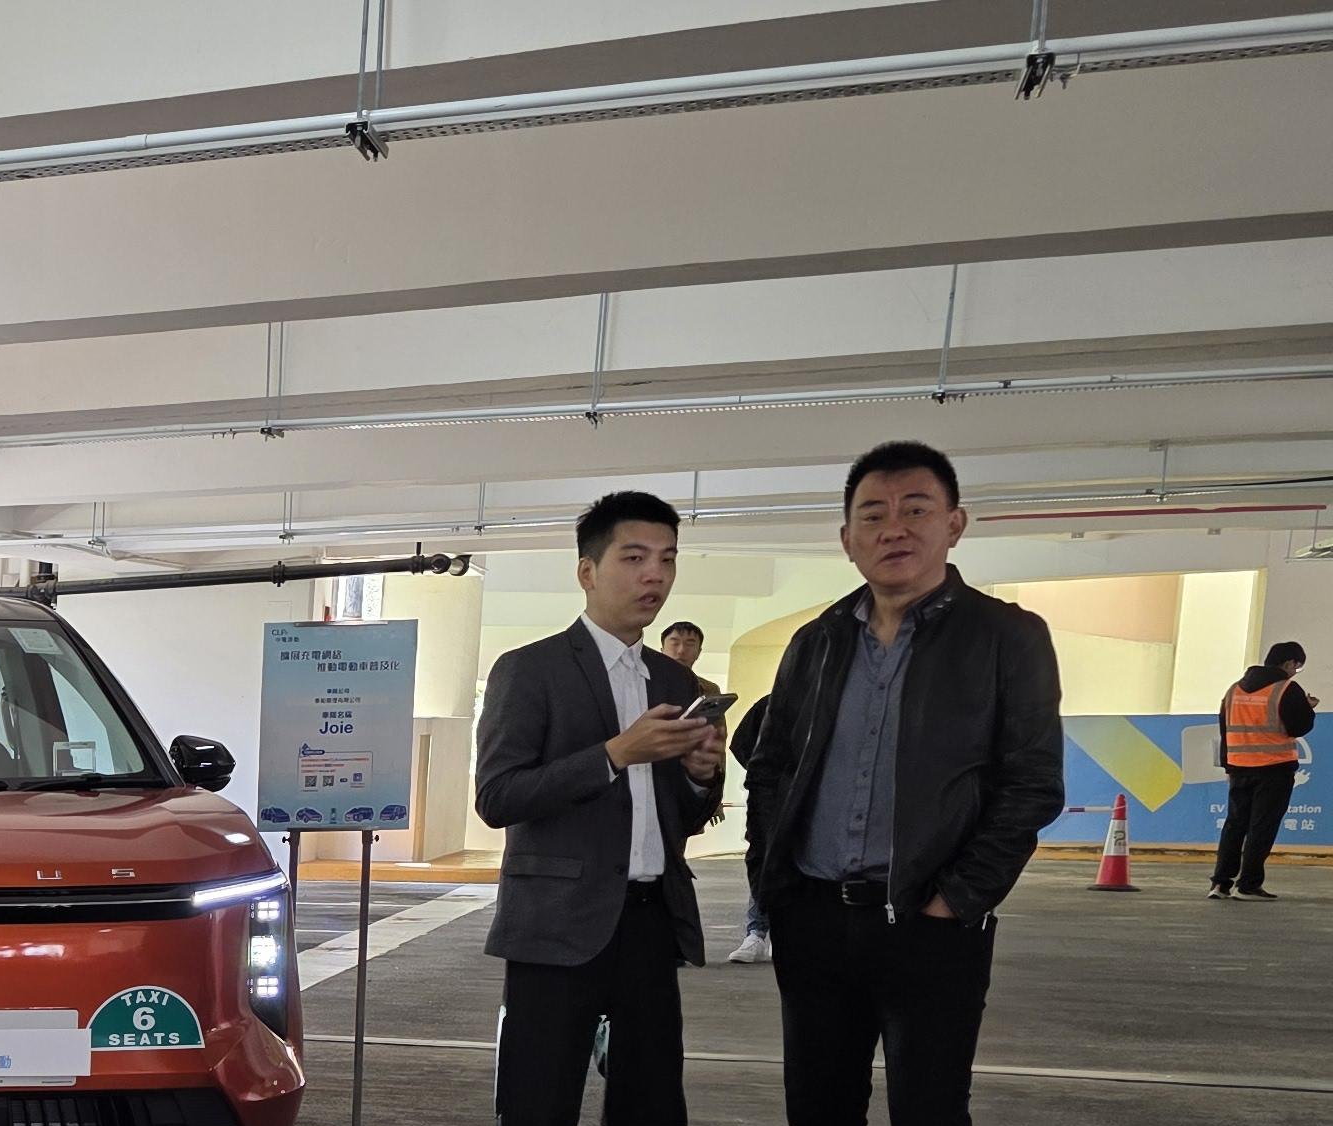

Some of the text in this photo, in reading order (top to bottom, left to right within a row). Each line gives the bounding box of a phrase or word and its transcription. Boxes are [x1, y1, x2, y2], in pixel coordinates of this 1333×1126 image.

[319, 721, 353, 735] Joie
[1210, 804, 1322, 813] EV tation
[120, 990, 170, 1007] TAXI
[132, 1006, 156, 1031] 6
[108, 1032, 180, 1046] SEATS
